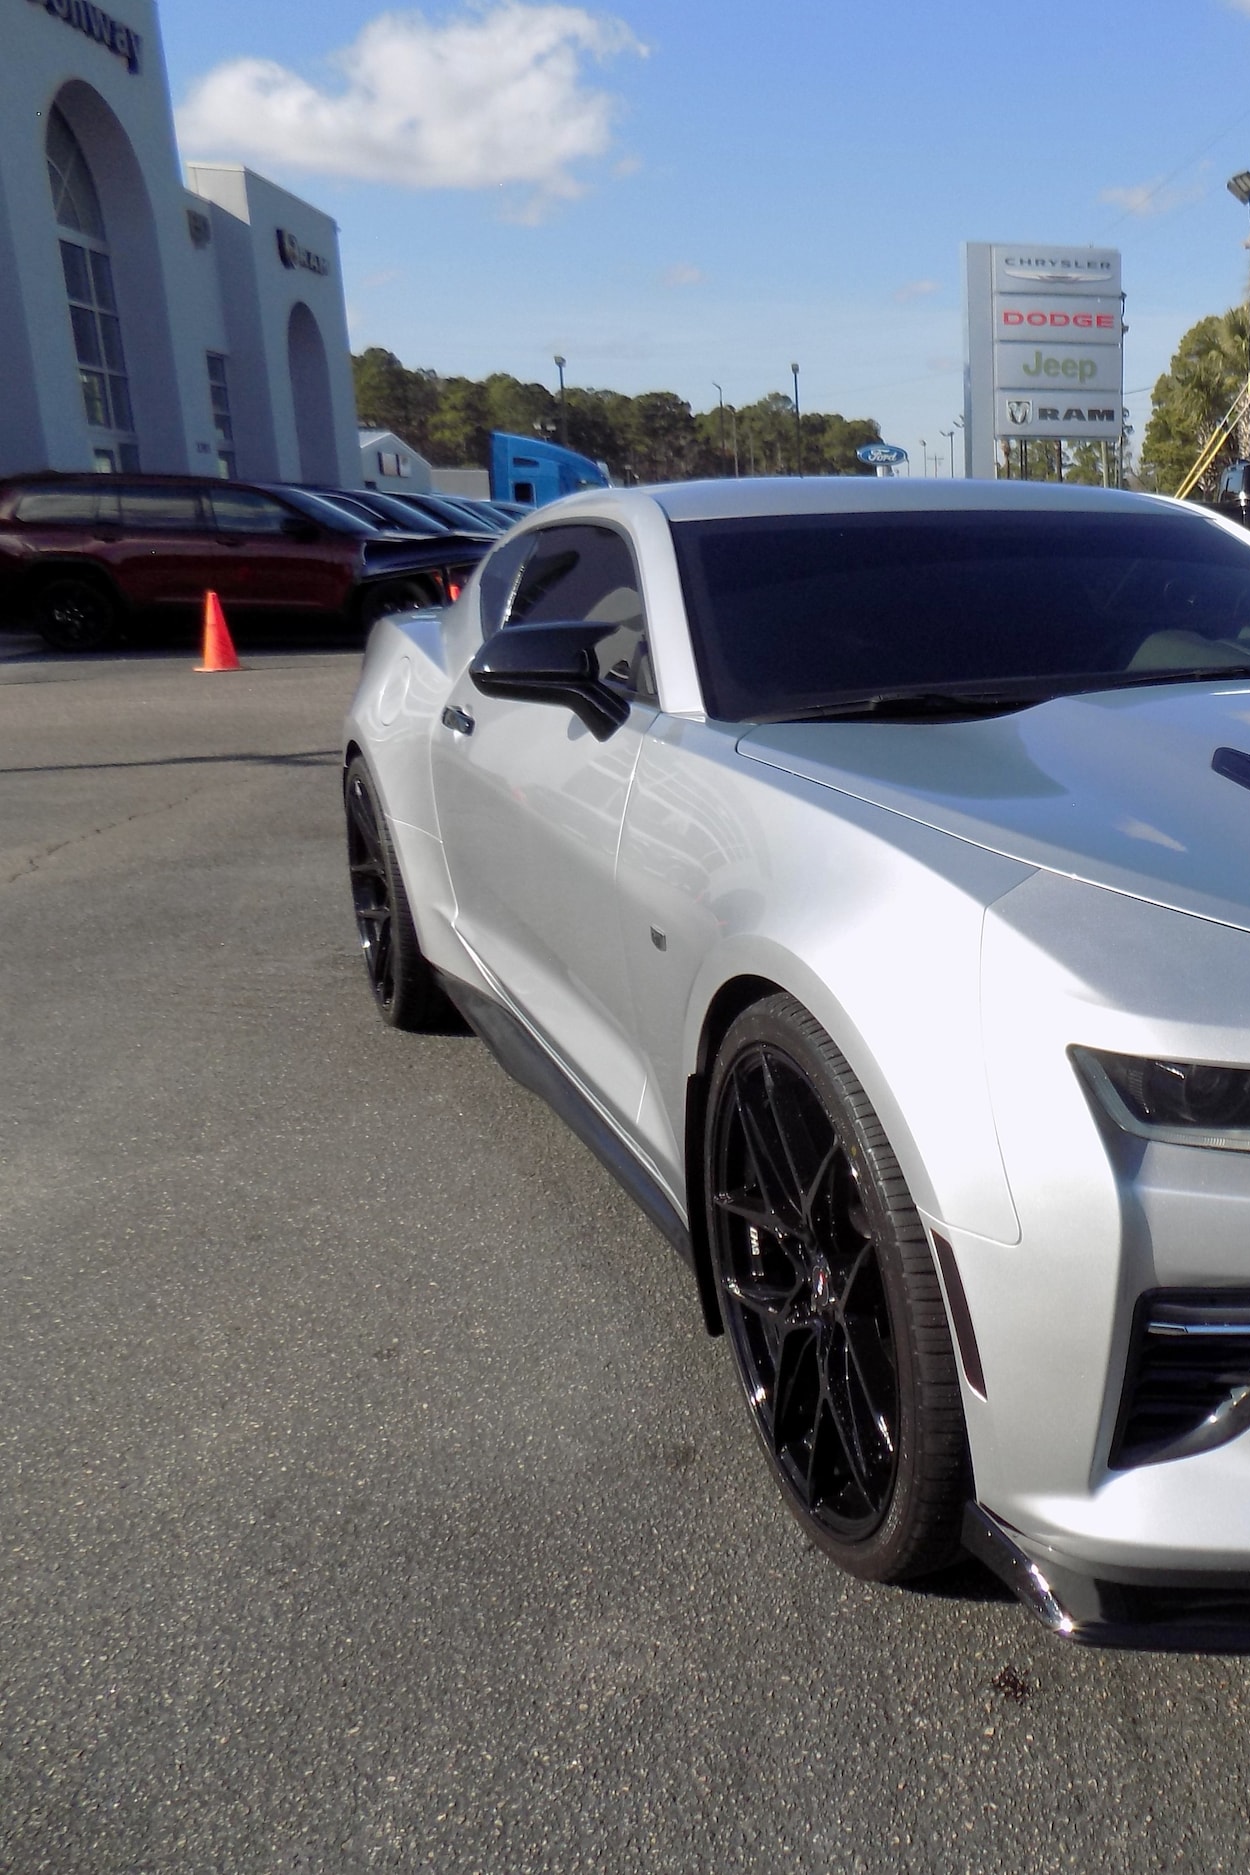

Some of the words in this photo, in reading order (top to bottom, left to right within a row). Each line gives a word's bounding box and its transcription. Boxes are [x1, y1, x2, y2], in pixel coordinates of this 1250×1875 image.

[1004, 257, 1112, 270] CHRYSLER
[1003, 310, 1115, 329] DODGE
[1022, 350, 1098, 384] Jeep
[1038, 407, 1115, 422] RAM
[868, 449, 898, 462] Ford
